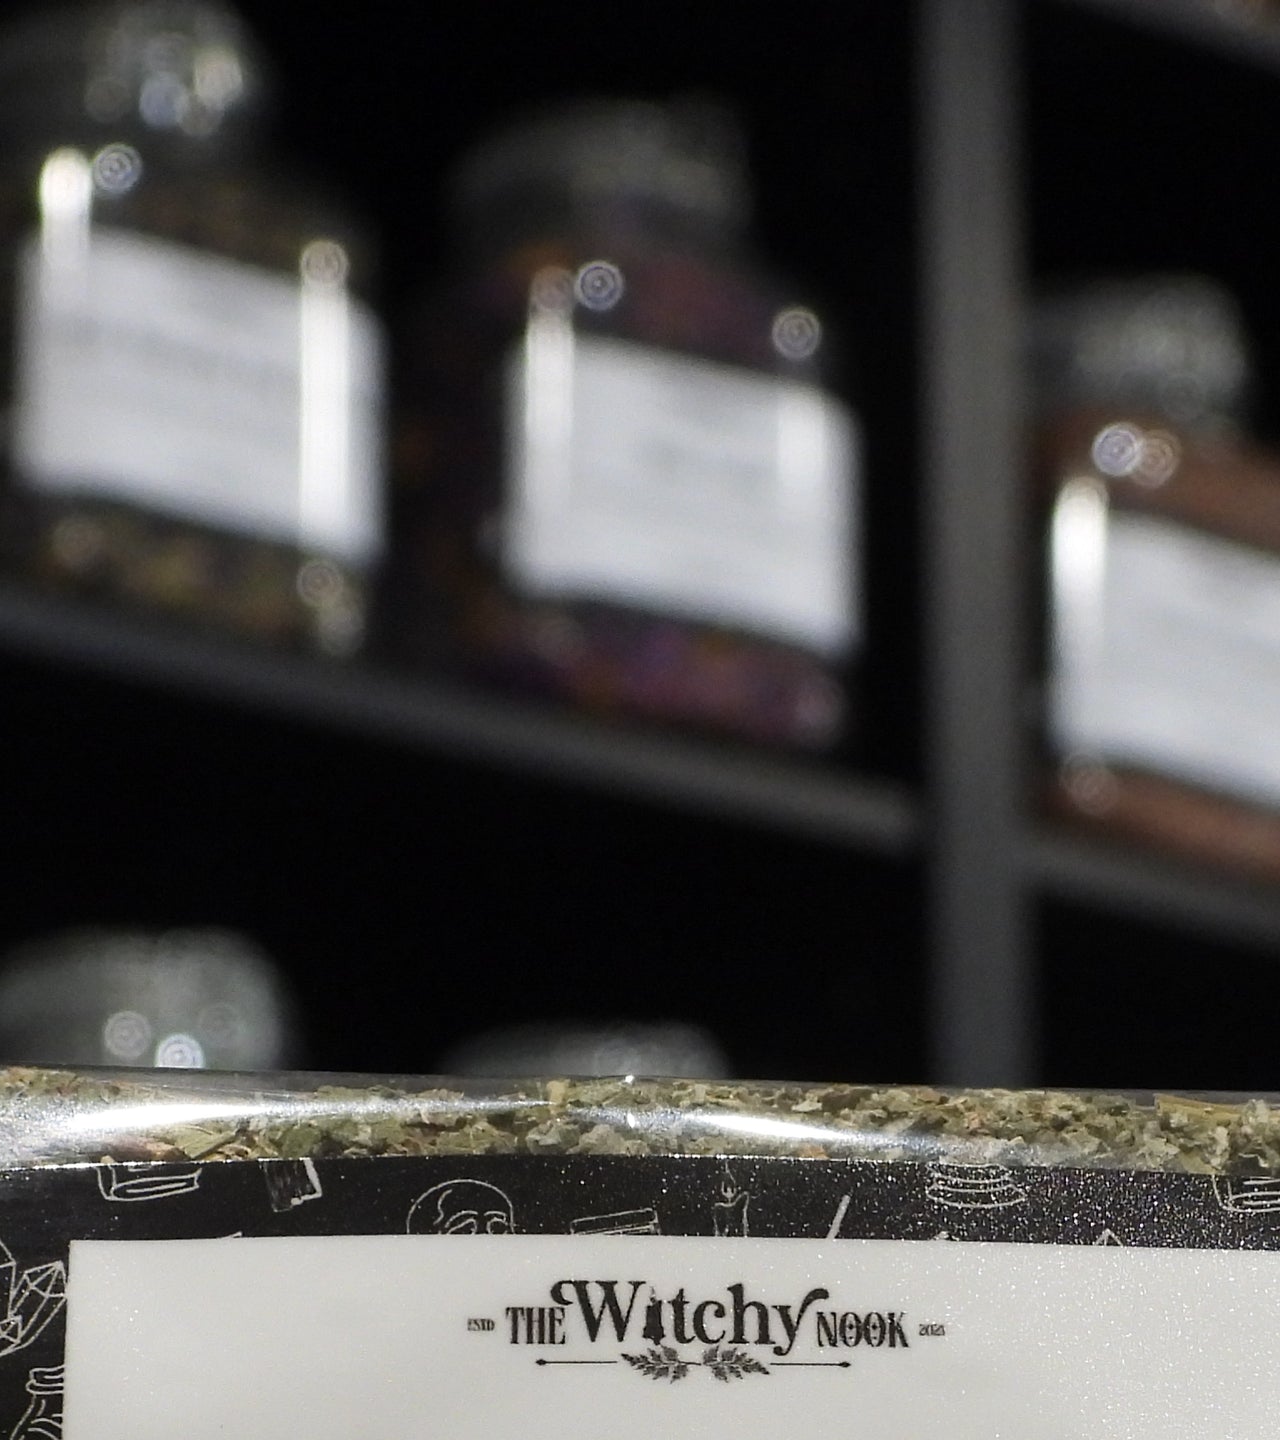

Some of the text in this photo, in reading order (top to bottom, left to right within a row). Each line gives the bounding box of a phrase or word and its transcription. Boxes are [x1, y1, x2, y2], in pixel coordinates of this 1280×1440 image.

[505, 1306, 567, 1345] THE
[550, 1279, 830, 1356] Witchy
[816, 1310, 910, 1348] NOOK
